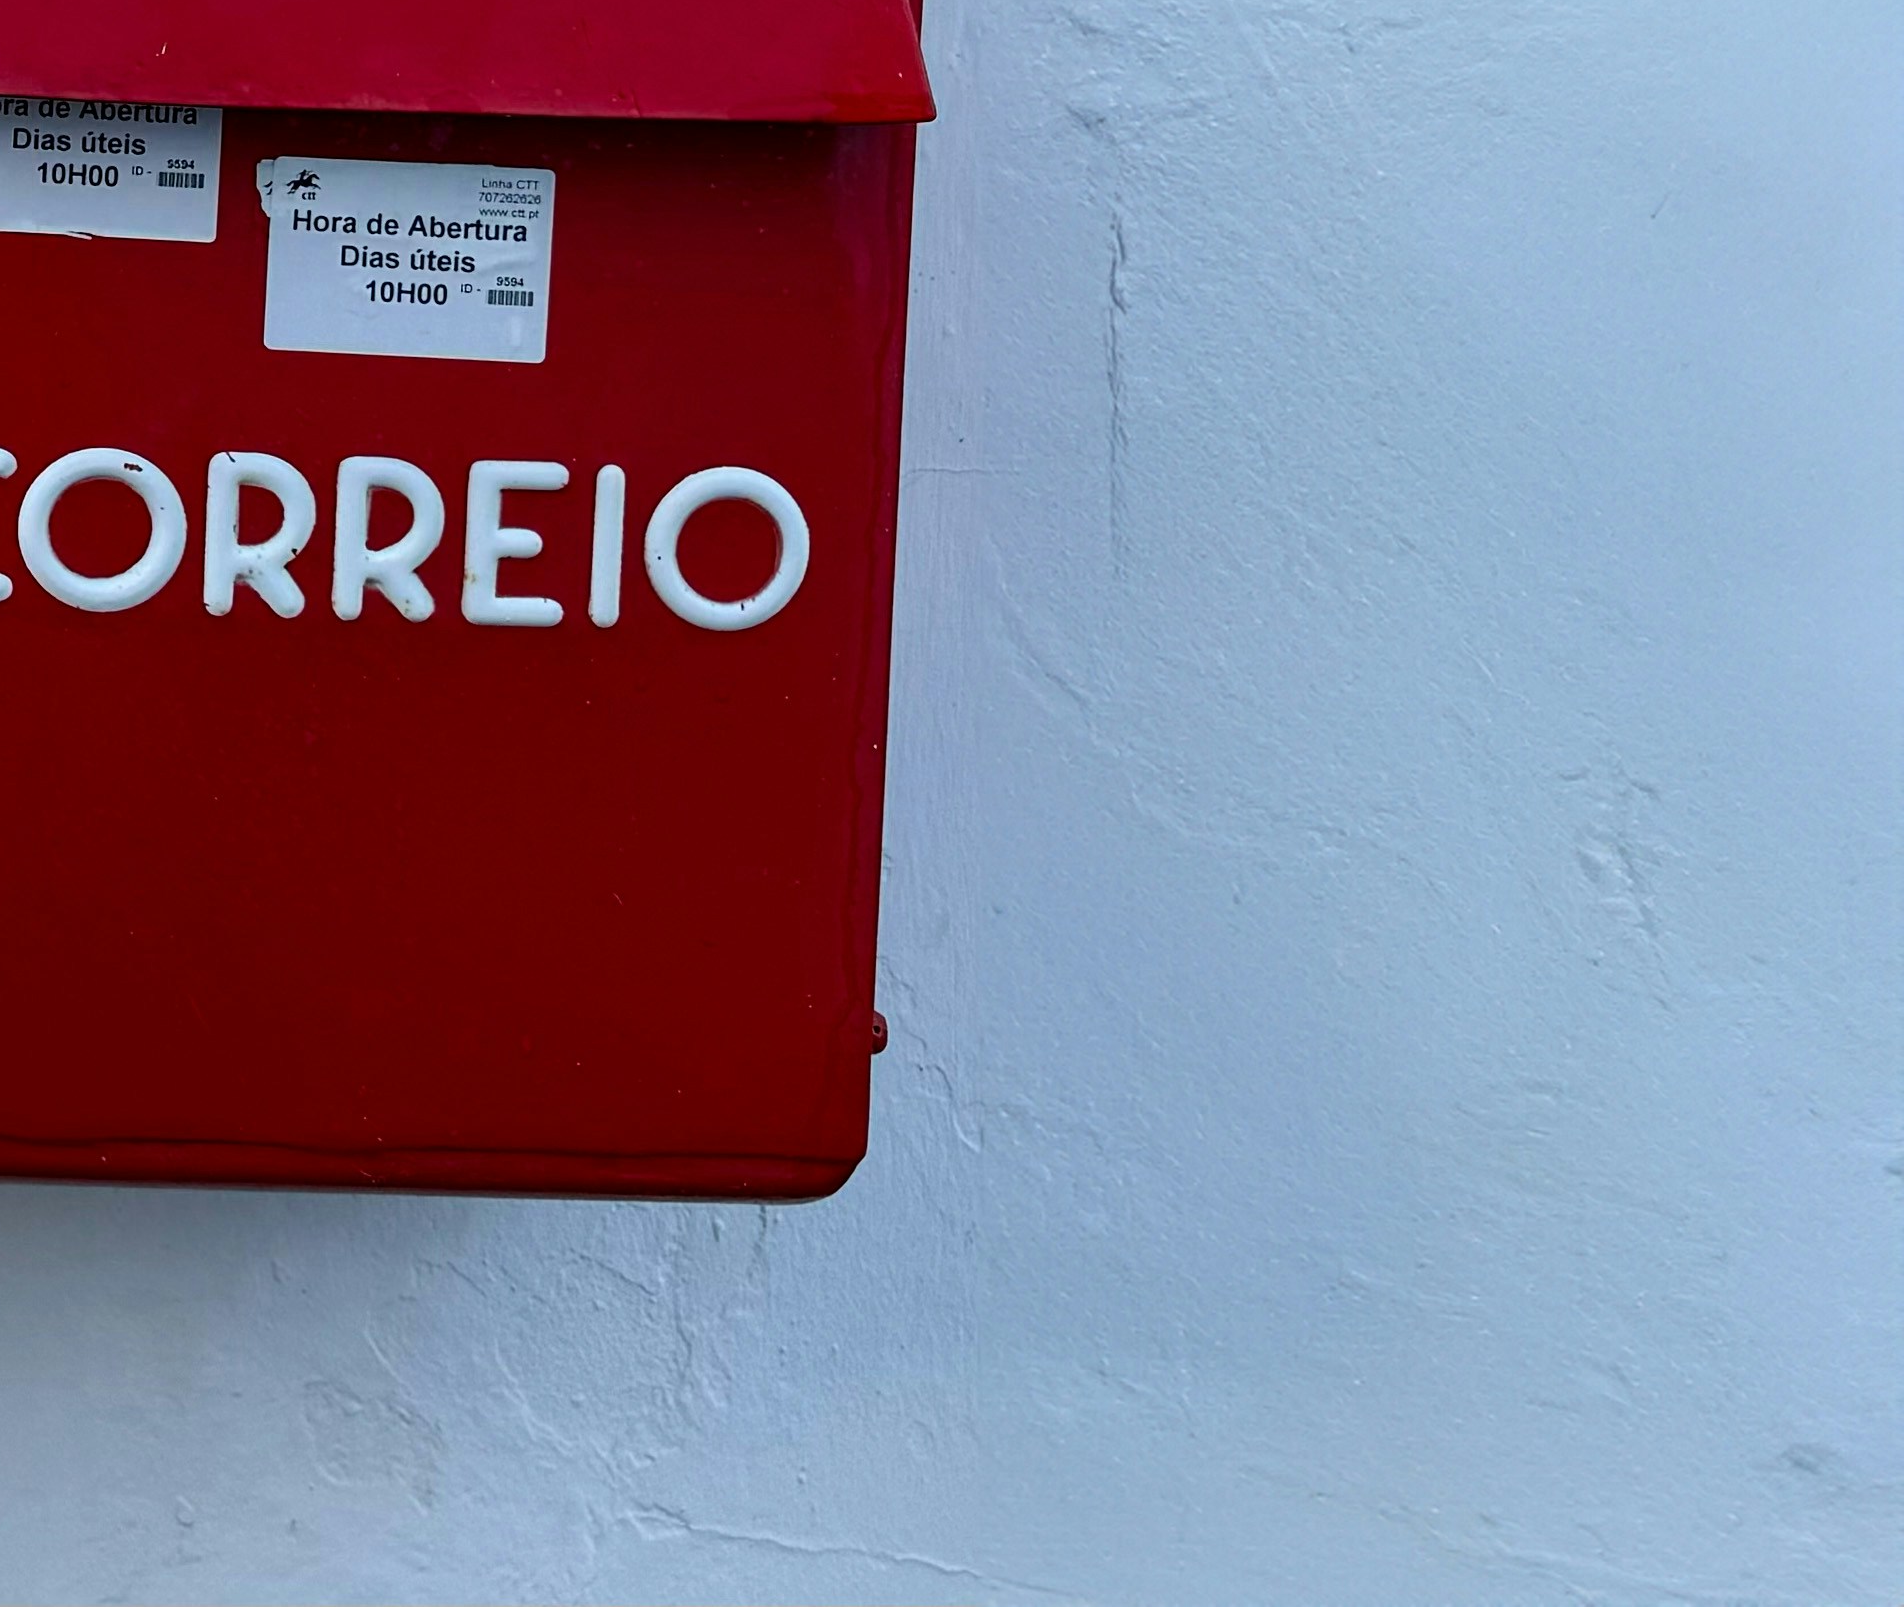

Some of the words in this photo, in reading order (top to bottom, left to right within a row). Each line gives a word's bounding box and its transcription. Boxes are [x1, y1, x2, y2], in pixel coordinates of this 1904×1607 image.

[37, 98, 71, 119] de
[78, 100, 198, 125] Abertura
[12, 127, 72, 152] Dias
[81, 130, 146, 156] úteis
[37, 161, 119, 188] 10H00
[131, 165, 144, 176] ID
[481, 178, 513, 189] Linha
[516, 179, 540, 190] CTT
[479, 191, 542, 205] 707262626
[292, 209, 357, 234] Hora
[366, 213, 400, 236] de
[408, 214, 527, 243] Abertura
[478, 208, 540, 220] www.ctt.pt
[340, 245, 400, 269] Dias
[410, 248, 476, 274] úteis
[365, 280, 448, 306] 10H00
[460, 283, 473, 294] ID
